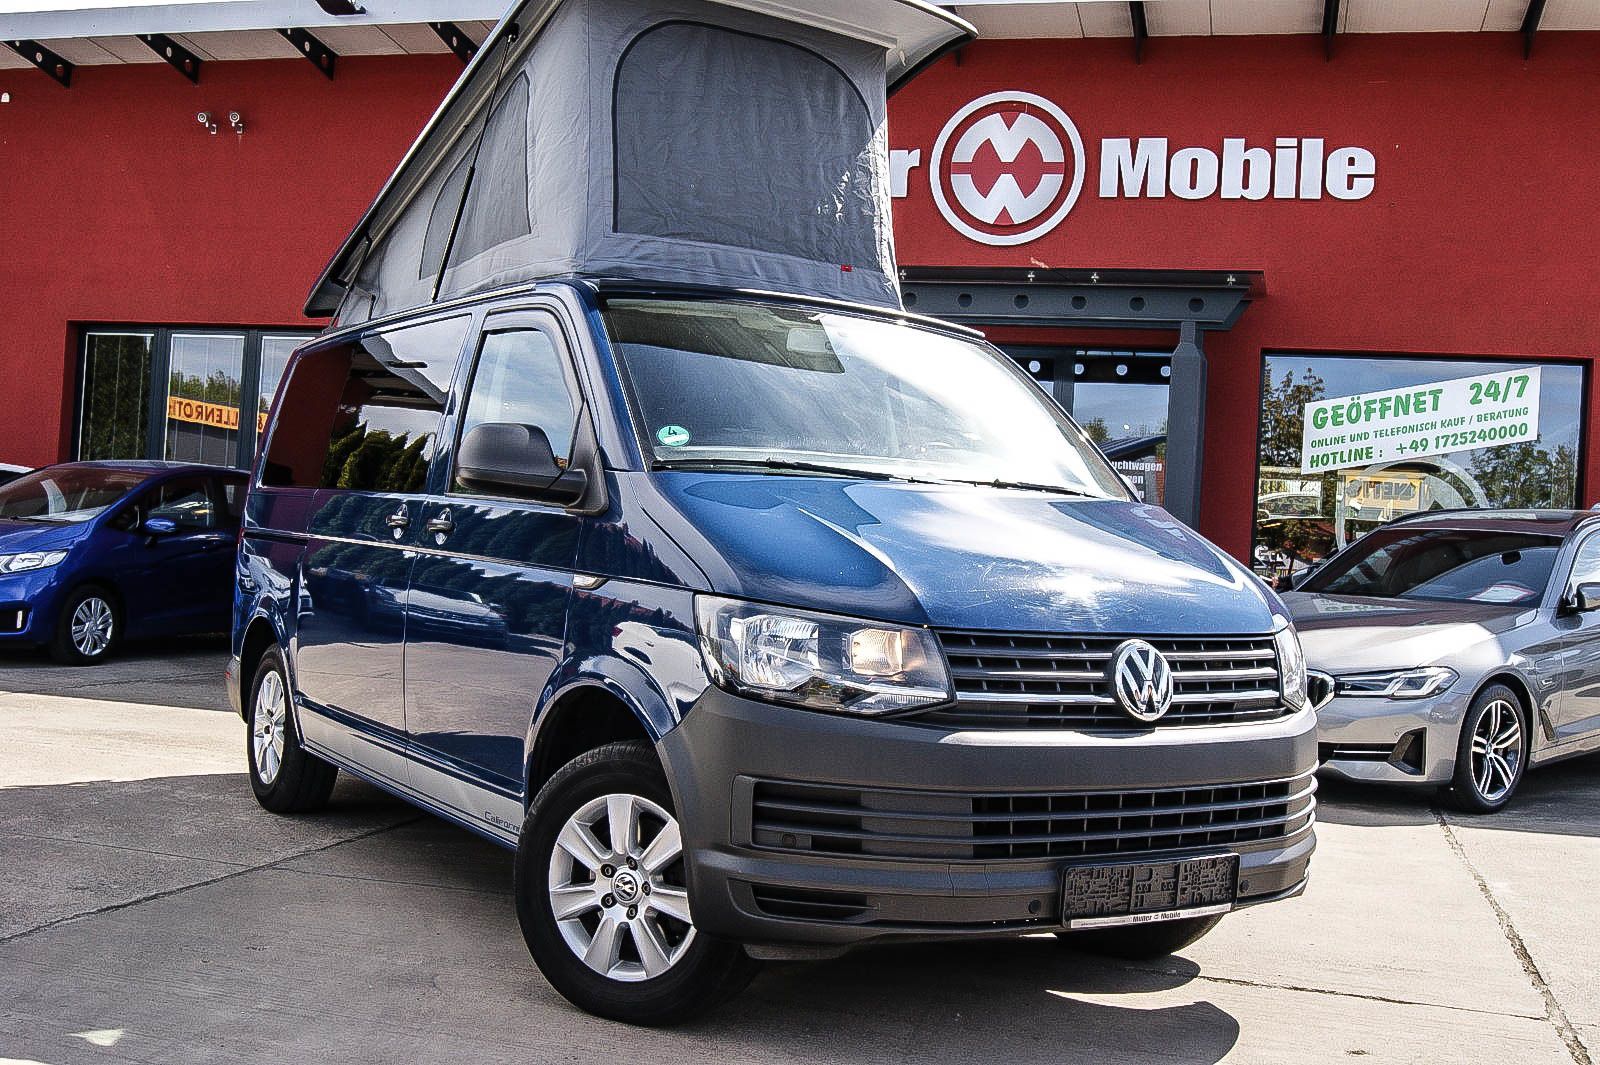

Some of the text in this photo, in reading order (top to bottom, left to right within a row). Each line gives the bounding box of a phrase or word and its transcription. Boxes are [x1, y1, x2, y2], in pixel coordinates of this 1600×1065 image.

[1099, 137, 1376, 200] Mobile
[1312, 375, 1530, 430] GEÖFFNET 24/7
[668, 426, 678, 436] 4
[1309, 446, 1374, 469] HOTLINE
[1396, 437, 1429, 455] +49
[1434, 422, 1529, 450] 1725240000
[1310, 435, 1346, 449] ONLINE
[1349, 431, 1370, 443] UND
[1373, 421, 1437, 439] TELEFONISCH
[1440, 416, 1466, 429] KAUF
[1476, 407, 1529, 423] BERATUNG
[484, 811, 521, 834] Californi
